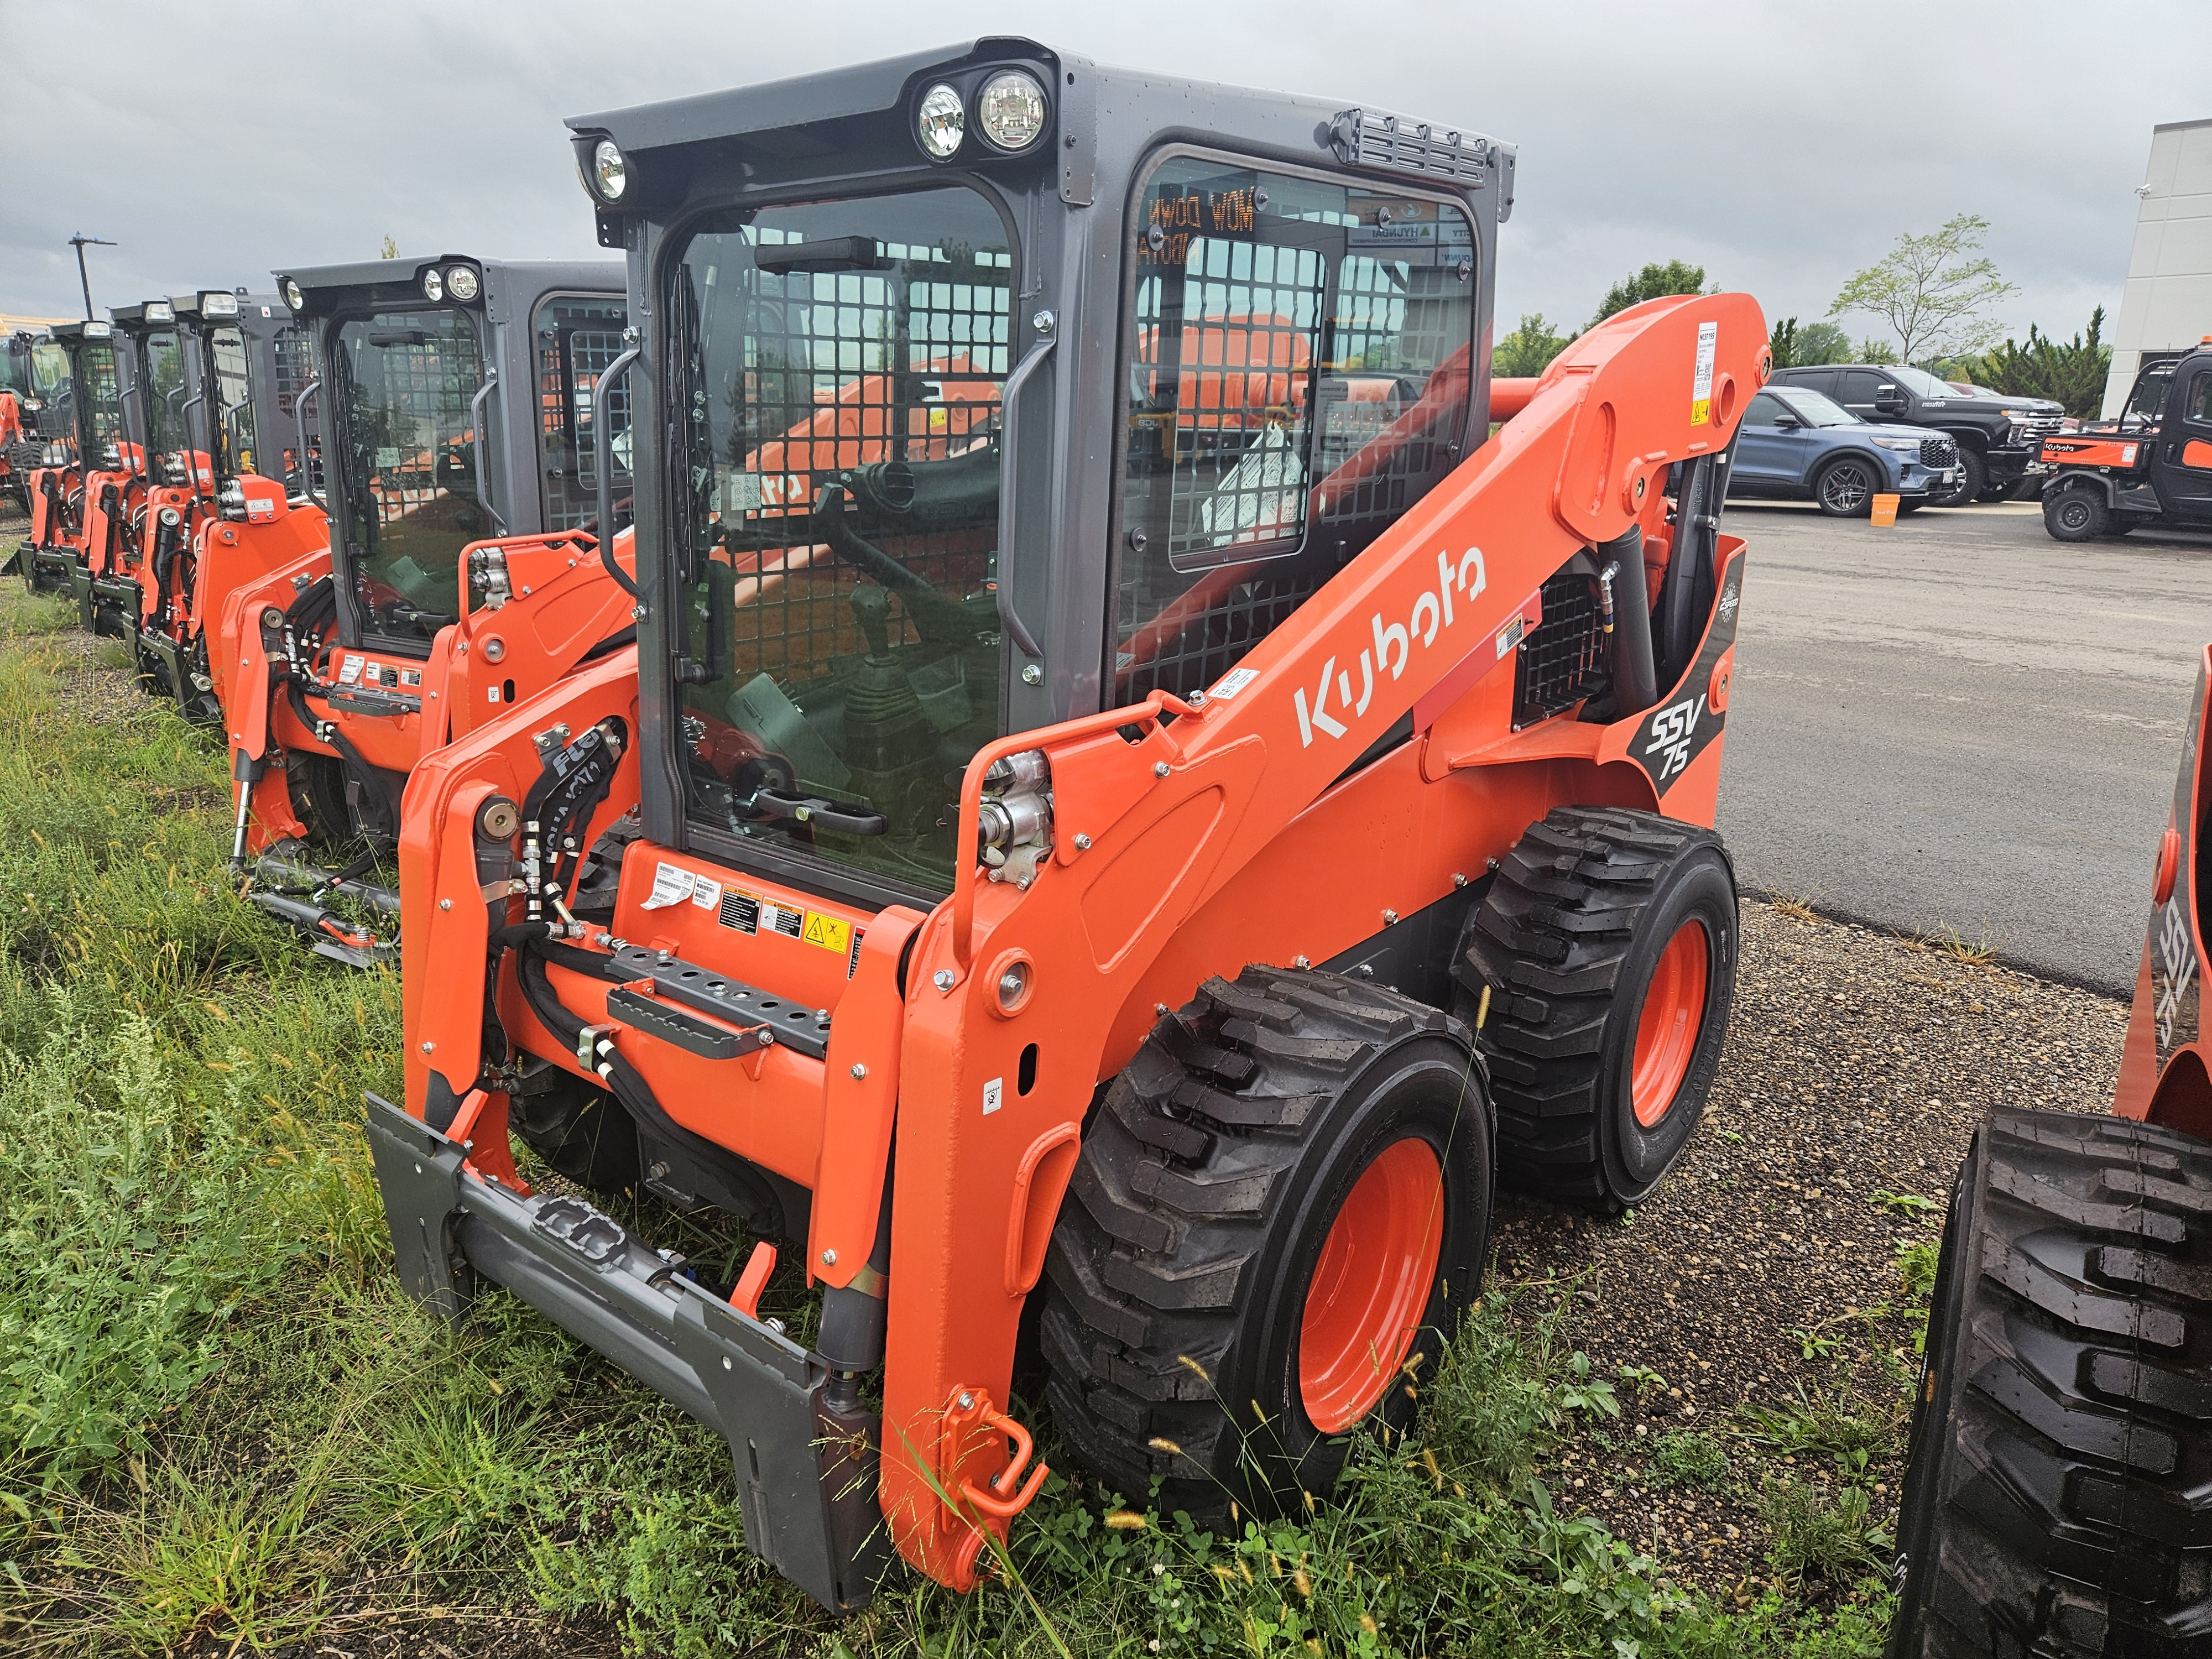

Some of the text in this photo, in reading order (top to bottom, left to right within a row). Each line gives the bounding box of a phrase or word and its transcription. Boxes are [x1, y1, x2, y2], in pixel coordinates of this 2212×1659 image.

[2046, 443, 2074, 452] Kubota
[1293, 547, 1486, 749] Kubota
[1645, 692, 1707, 755] SSV
[1659, 737, 1692, 781] 75
